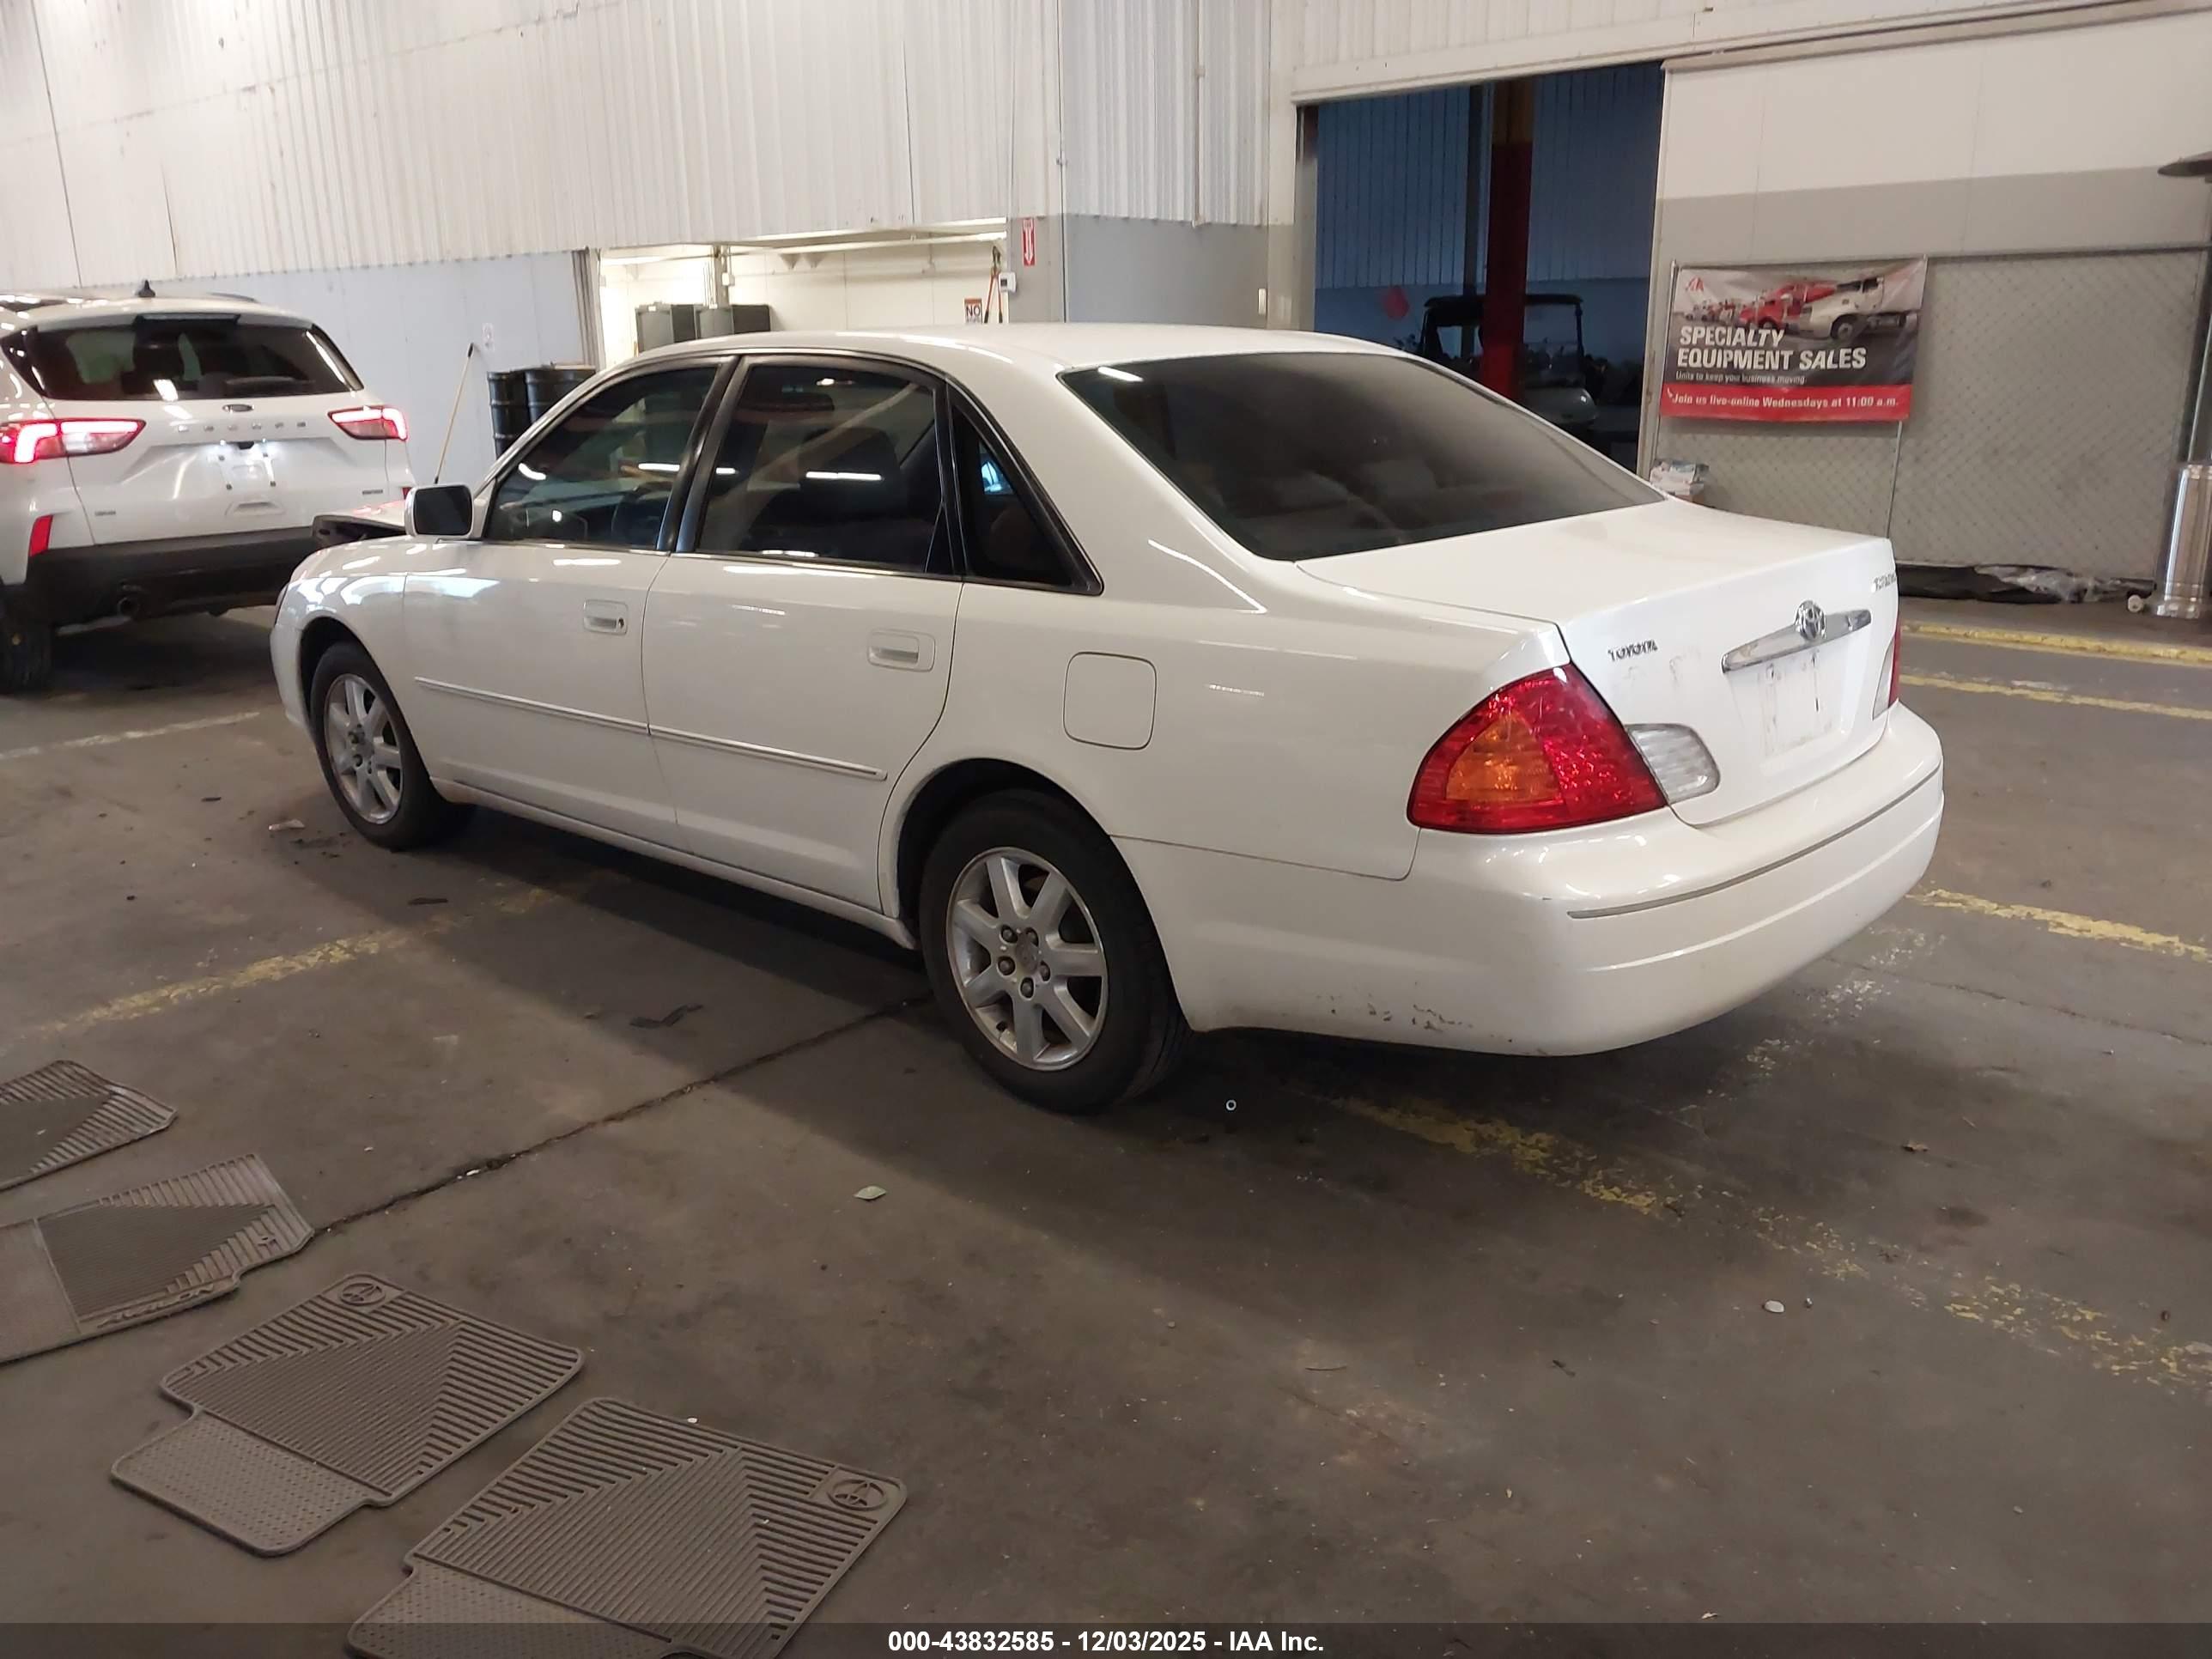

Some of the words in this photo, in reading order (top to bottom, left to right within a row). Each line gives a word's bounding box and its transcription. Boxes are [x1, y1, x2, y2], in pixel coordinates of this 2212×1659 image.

[966, 305, 981, 317] NO
[1680, 325, 1785, 347] SPECIALTY
[1677, 348, 1794, 370] EQUIPMENT
[1799, 347, 1867, 370] SALES
[1675, 370, 1694, 381] Units
[1696, 372, 1704, 381] to
[1705, 372, 1724, 383] keep
[1725, 374, 1740, 384] your
[1742, 374, 1774, 384] business
[1673, 392, 1692, 404] Join
[1696, 396, 1707, 404] us
[1710, 394, 1760, 407] live-online
[1762, 396, 1828, 410] Wednesdays
[1831, 397, 1842, 408] at
[1846, 396, 1874, 408] 11:00
[1876, 397, 1899, 408] a.m.
[1607, 640, 1658, 662] TOYOTA
